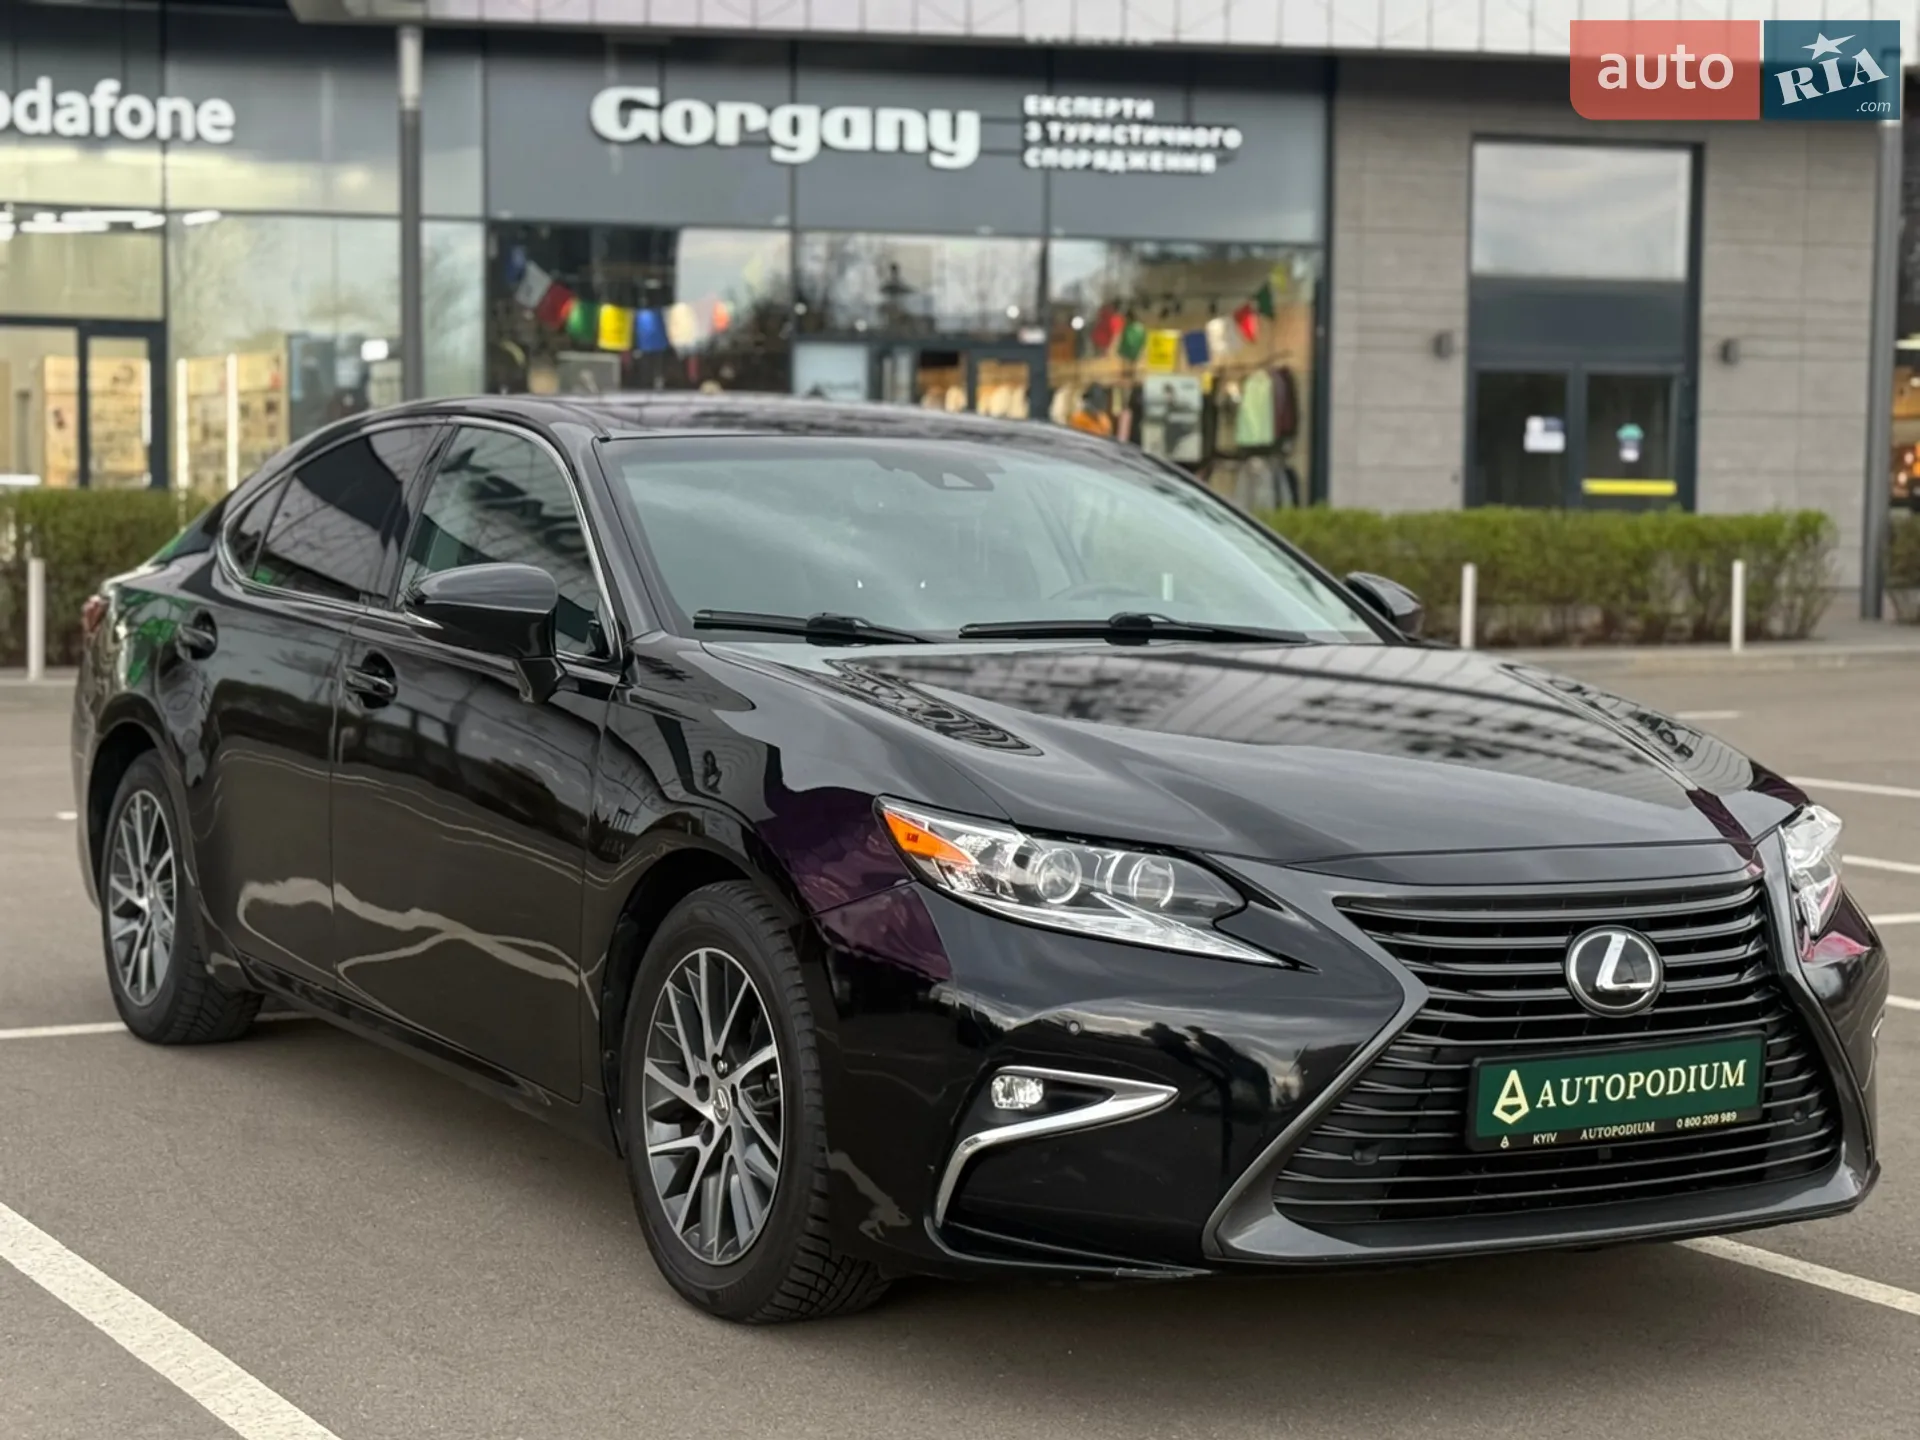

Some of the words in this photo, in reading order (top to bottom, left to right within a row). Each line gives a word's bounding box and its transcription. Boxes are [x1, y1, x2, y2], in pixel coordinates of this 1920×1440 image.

[0, 76, 236, 143] dafone
[590, 86, 982, 169] Gorgany
[1536, 1059, 1746, 1109] AUTOPODIUM
[1532, 1132, 1558, 1146] KYIV
[1580, 1121, 1656, 1141] AUTOPODIUM
[1676, 1117, 1683, 1129] 0
[1684, 1116, 1701, 1128] 800
[1702, 1113, 1720, 1125] 209
[1721, 1111, 1737, 1123] 989
